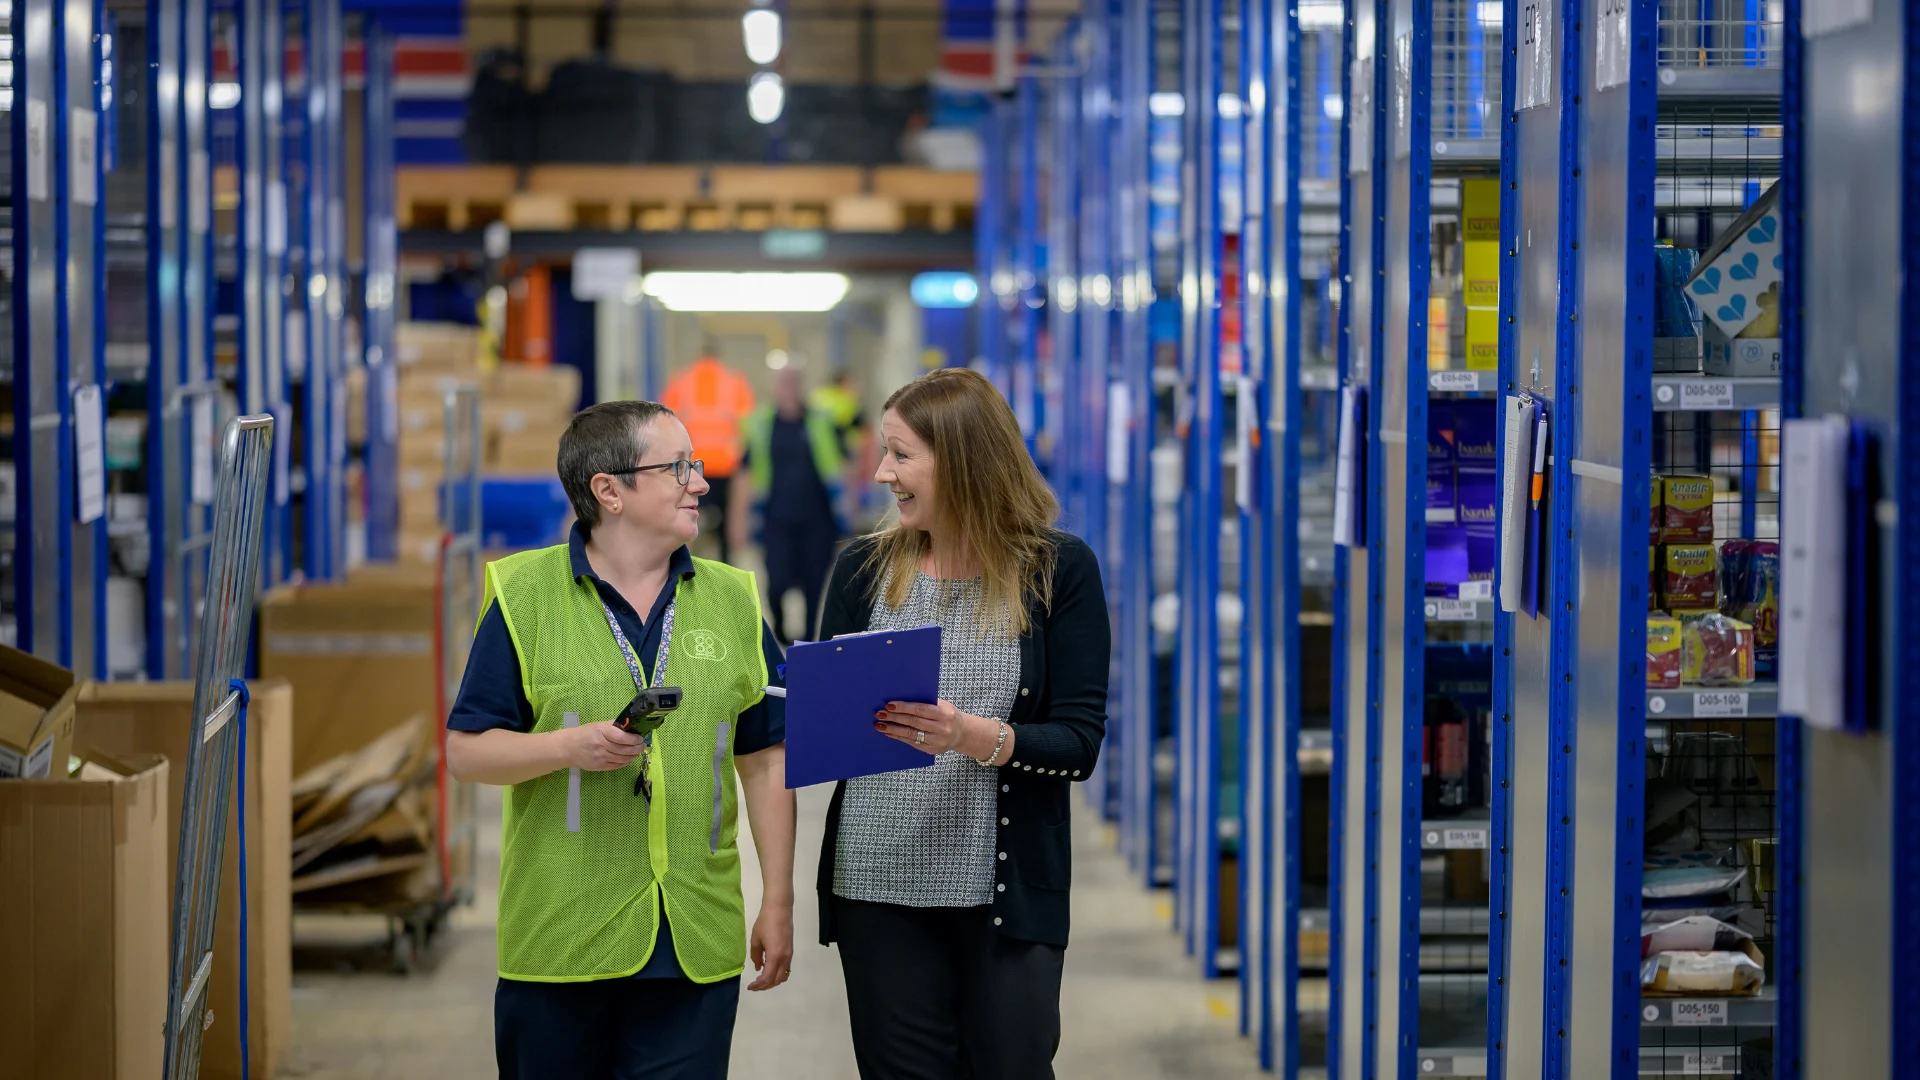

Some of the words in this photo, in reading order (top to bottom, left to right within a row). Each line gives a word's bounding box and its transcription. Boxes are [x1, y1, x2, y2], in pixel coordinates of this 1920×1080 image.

[1747, 346, 1758, 355] 70
[1441, 374, 1472, 382] E05-050
[1685, 384, 1727, 396] D05-050
[1670, 482, 1708, 493] Anadin
[1674, 493, 1704, 501] EXTRA
[1672, 547, 1710, 560] Anadin
[1676, 559, 1705, 567] EXTRA
[1441, 600, 1472, 610] E05-100
[1700, 694, 1740, 706] D05-100
[1449, 832, 1480, 841] E05-150
[1678, 1003, 1720, 1014] D05-150
[1688, 1055, 1718, 1065] E0-202
